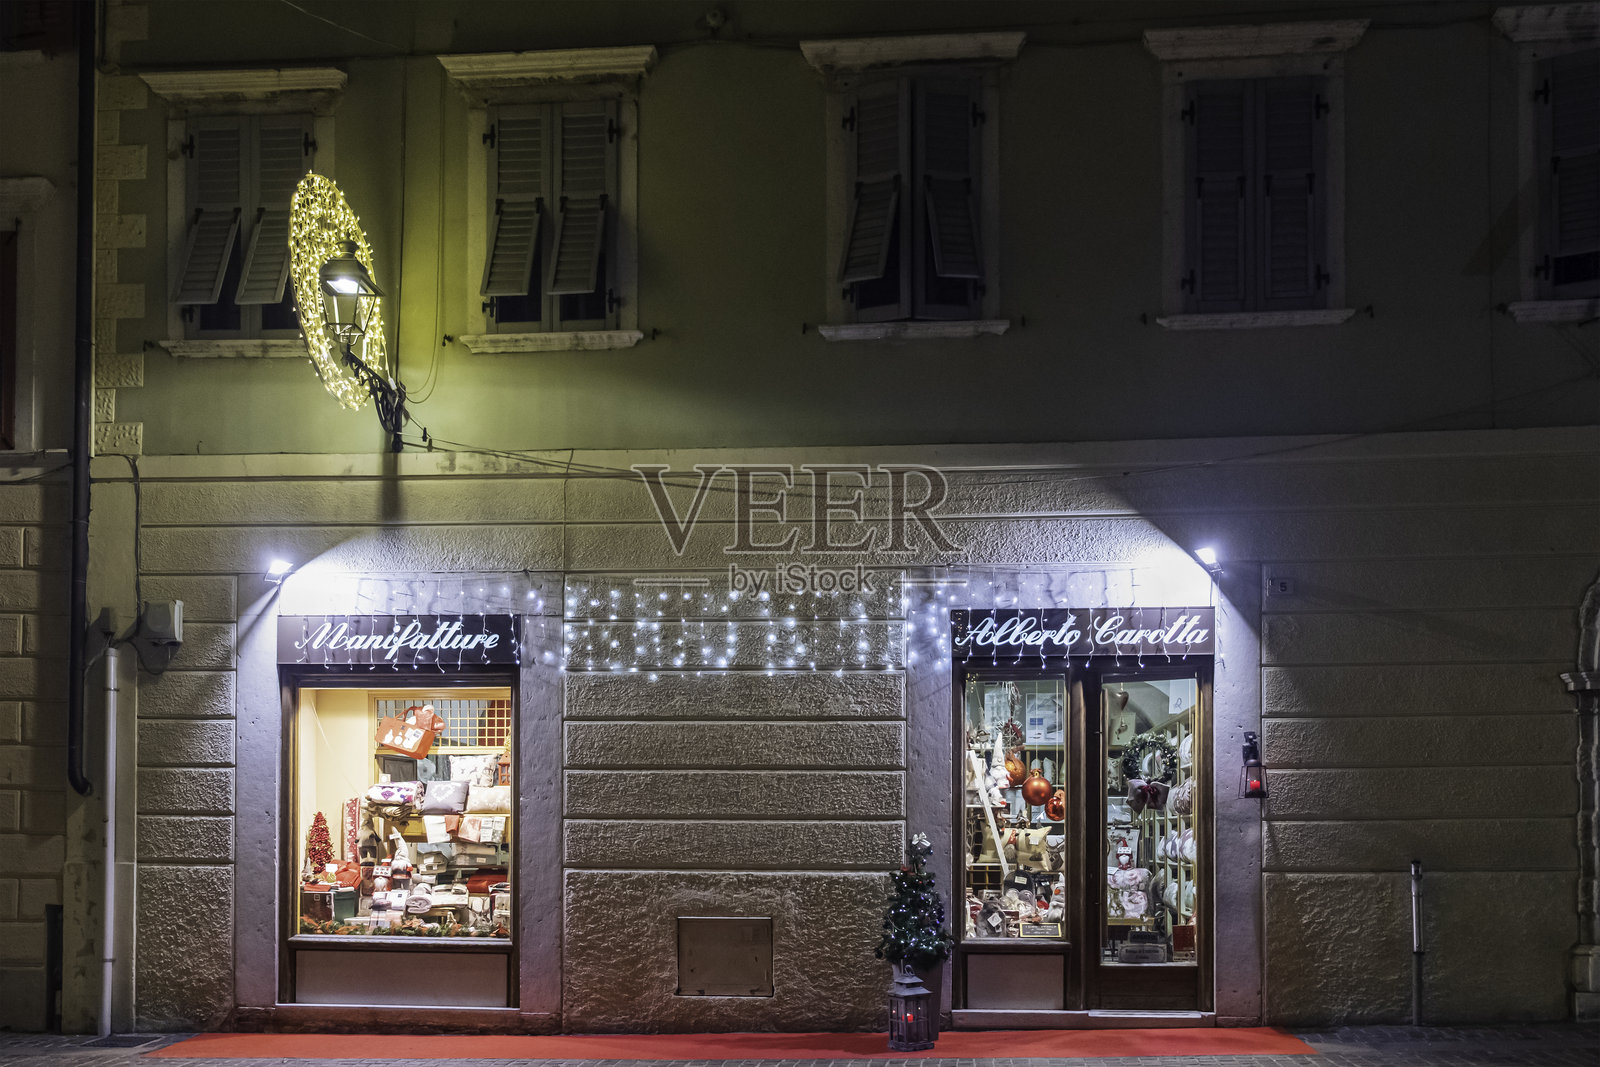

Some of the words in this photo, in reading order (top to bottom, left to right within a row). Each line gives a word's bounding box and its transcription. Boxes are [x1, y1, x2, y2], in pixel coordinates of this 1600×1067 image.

[1280, 581, 1288, 592] 5
[294, 621, 500, 660] Manifatture
[954, 616, 1081, 646] Alberto
[1094, 615, 1208, 645] Carotta
